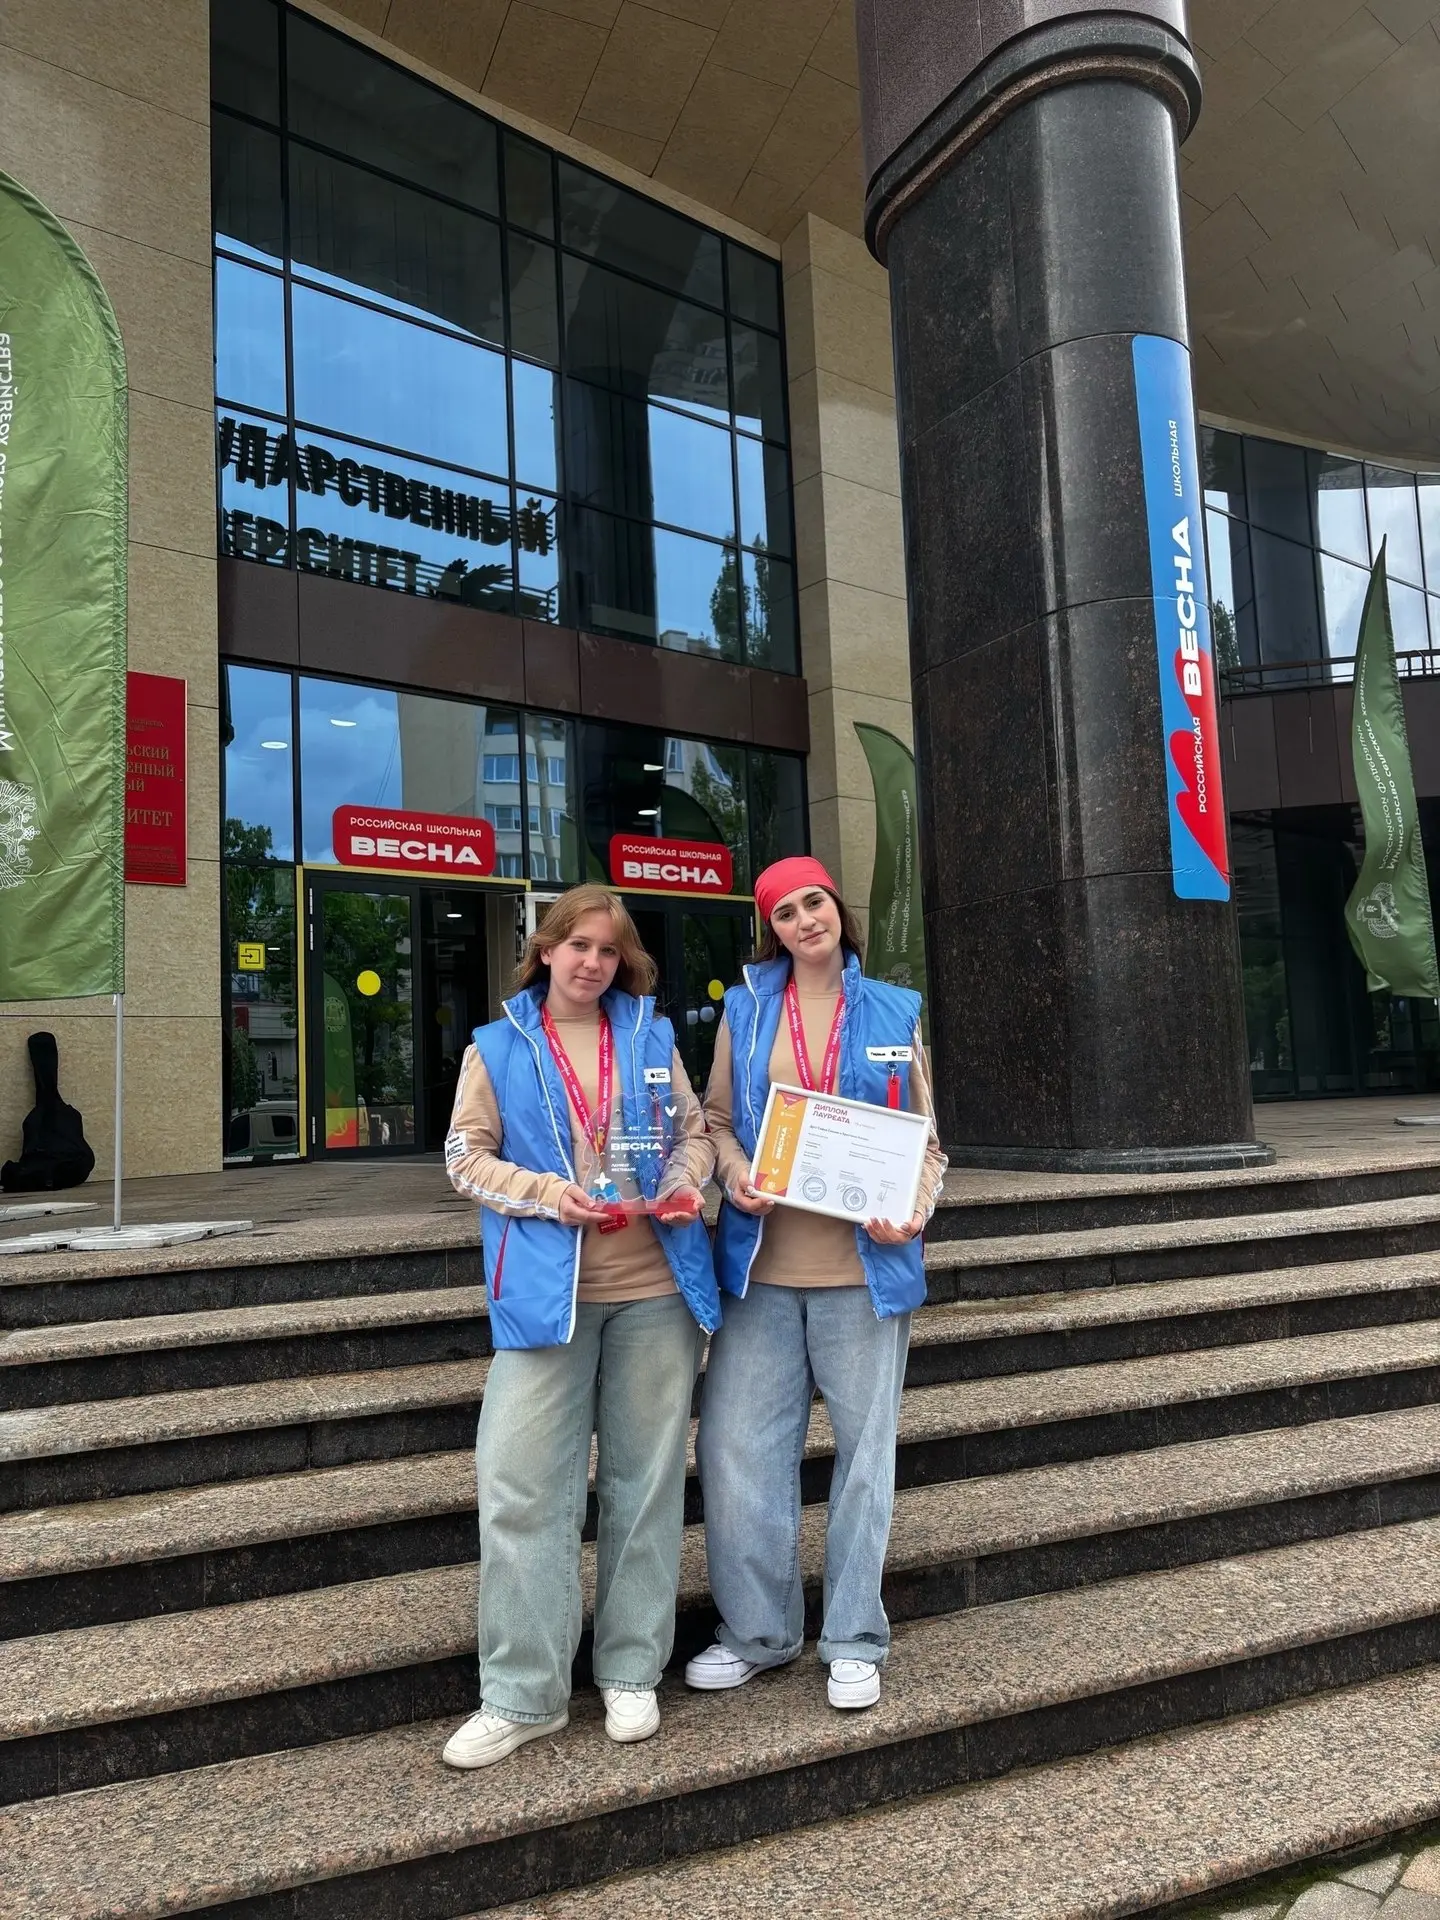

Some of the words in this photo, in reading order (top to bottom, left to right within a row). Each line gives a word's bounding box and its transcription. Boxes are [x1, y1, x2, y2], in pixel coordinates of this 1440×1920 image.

[1168, 419, 1183, 497] ШКОЛЬНАЯ
[1172, 516, 1202, 696] ВЕСНА
[1192, 716, 1207, 813] РОССИЙСКАЯ
[350, 817, 422, 832] РОССИЙСКАЯ
[427, 824, 482, 838] ШКОЛЬНАЯ
[351, 835, 482, 866] ВЕСНА
[622, 844, 677, 857] РОССИЙСКАЯ
[679, 850, 722, 861] ШКОЛЬНАЯ
[623, 861, 723, 886] ВЕСНА
[812, 1110, 851, 1125] ЛАУРЕАТА
[814, 1103, 848, 1116] ДИПЛОМ
[610, 1142, 664, 1151] ВЕСНА
